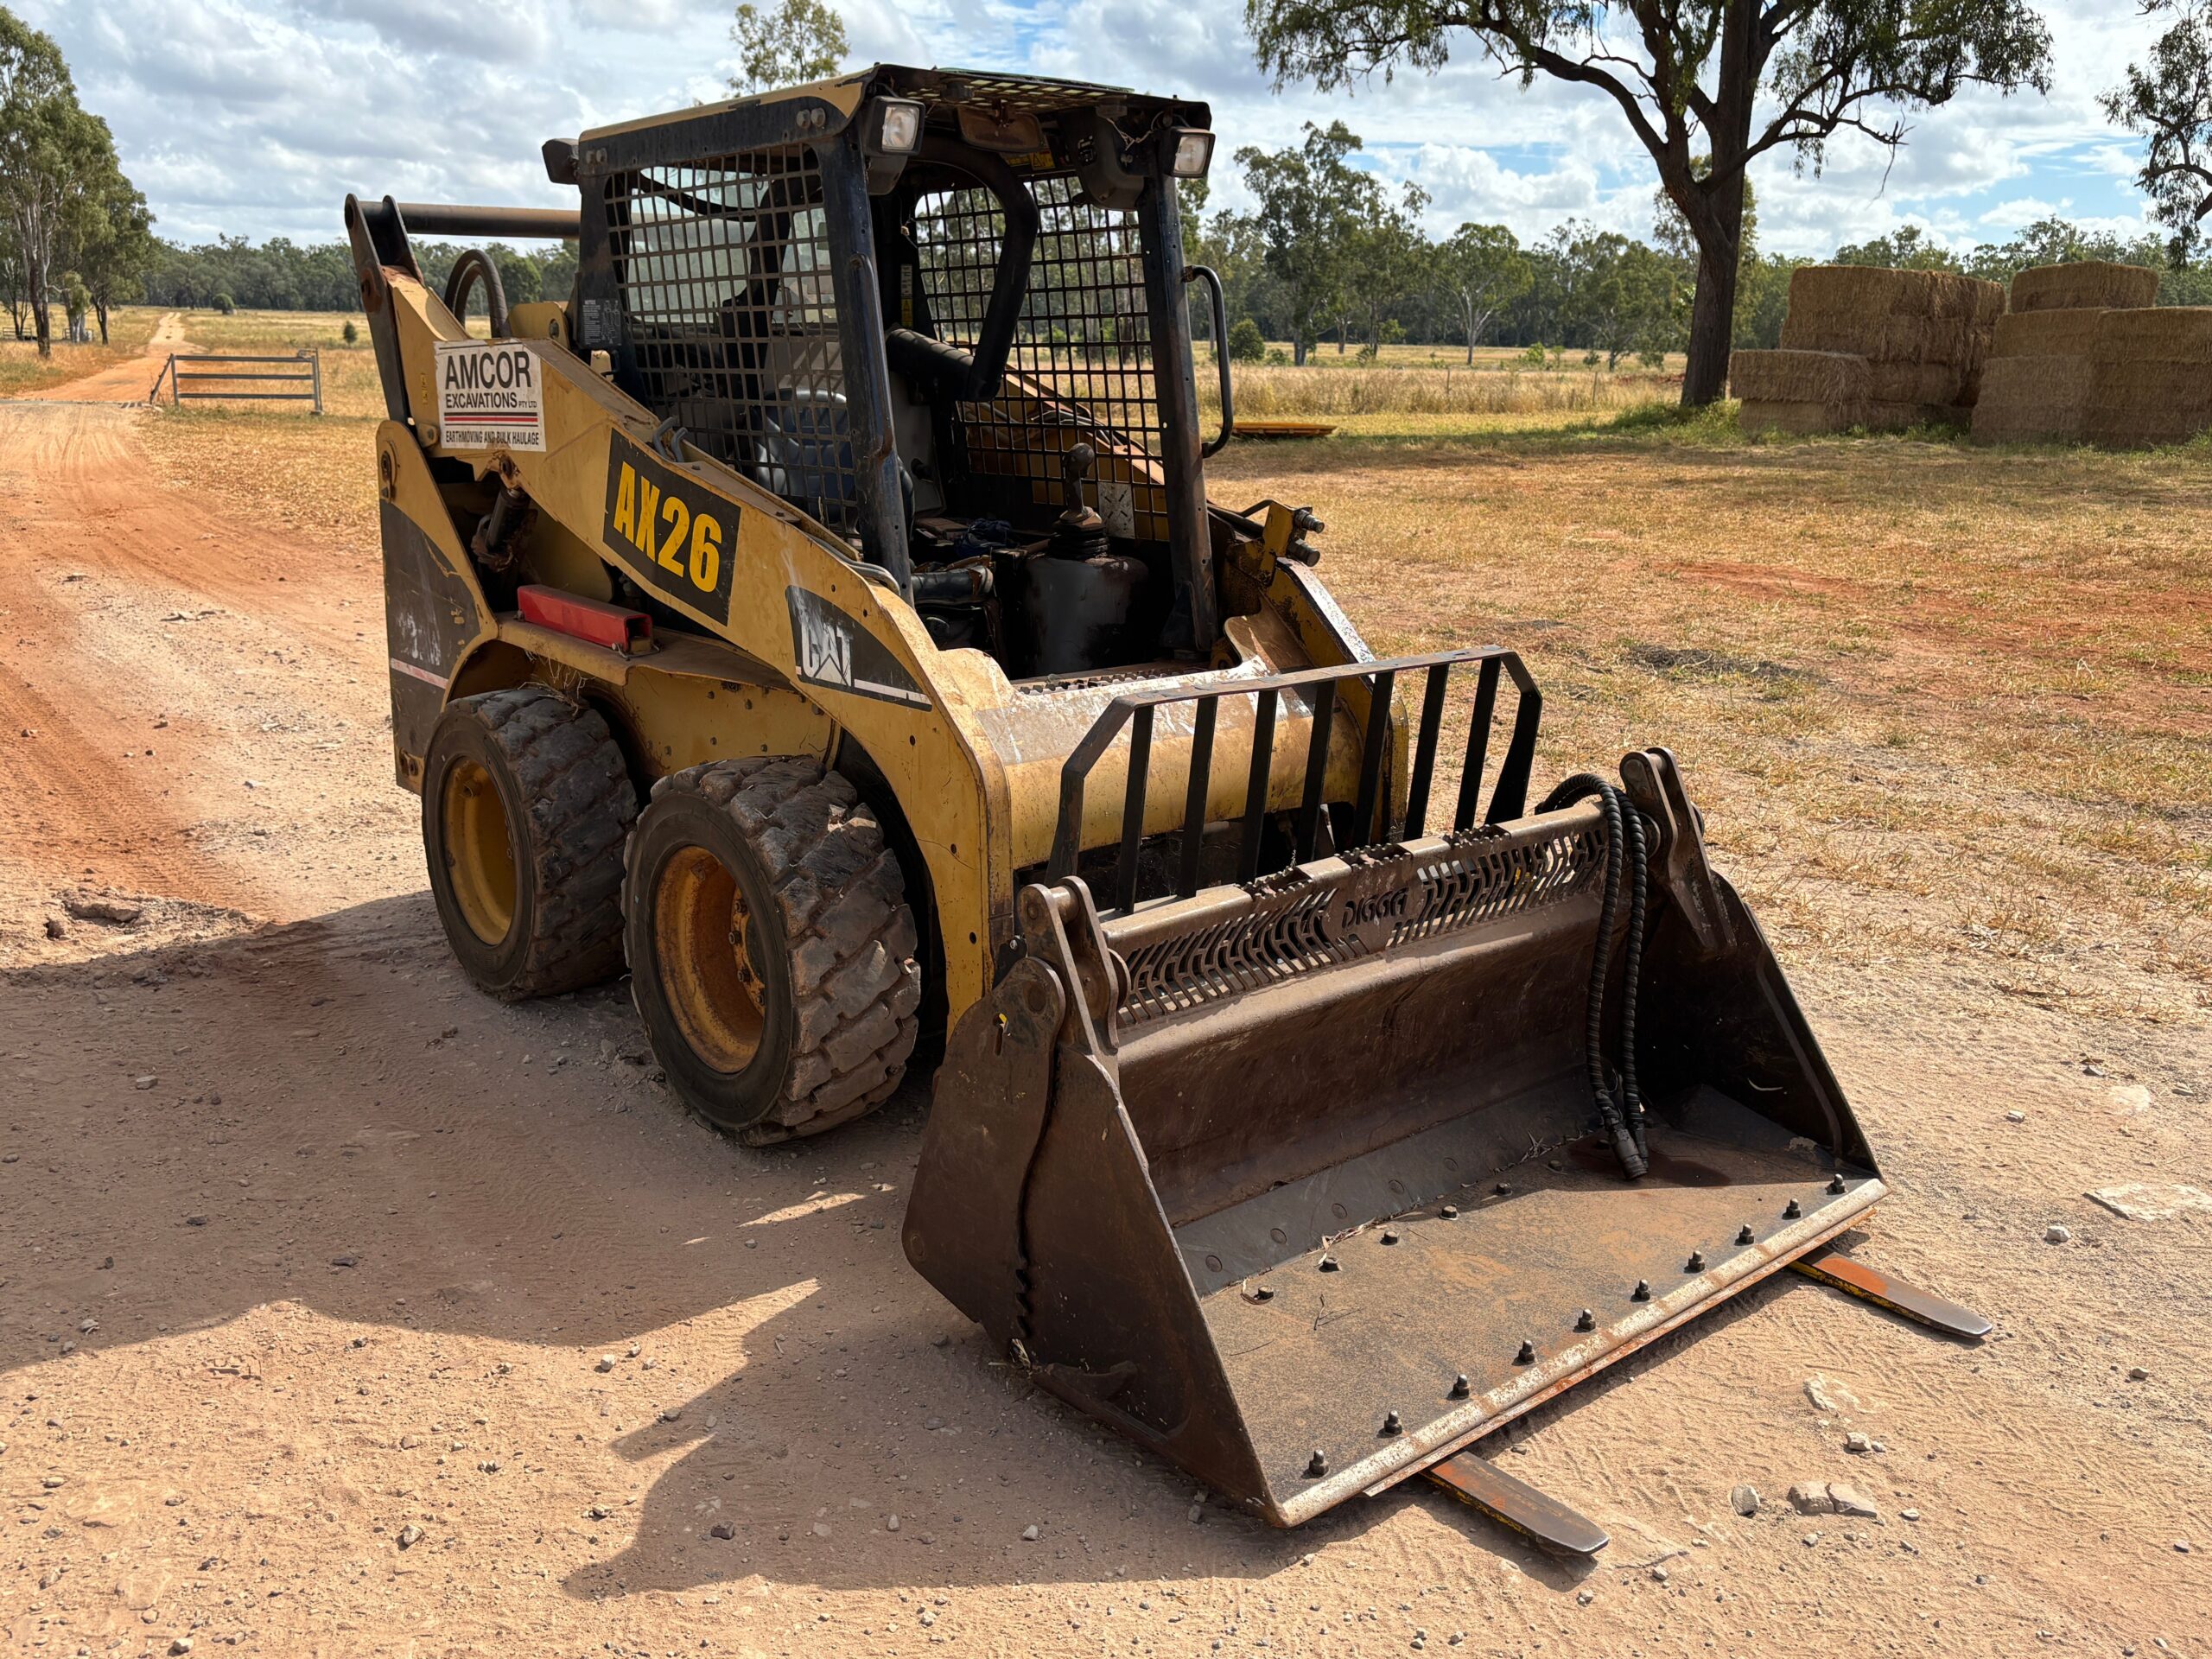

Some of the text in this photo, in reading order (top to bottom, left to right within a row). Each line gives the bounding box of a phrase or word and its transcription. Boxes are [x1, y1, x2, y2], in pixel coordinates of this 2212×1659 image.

[445, 351, 531, 390] AMCOR
[446, 391, 518, 409] EXCAVATIONS
[446, 431, 539, 445] EARTHMOVING AND BULK HAULAGE
[613, 461, 722, 593] AX26
[801, 620, 853, 687] CAT
[1342, 887, 1409, 929] DIGGA
